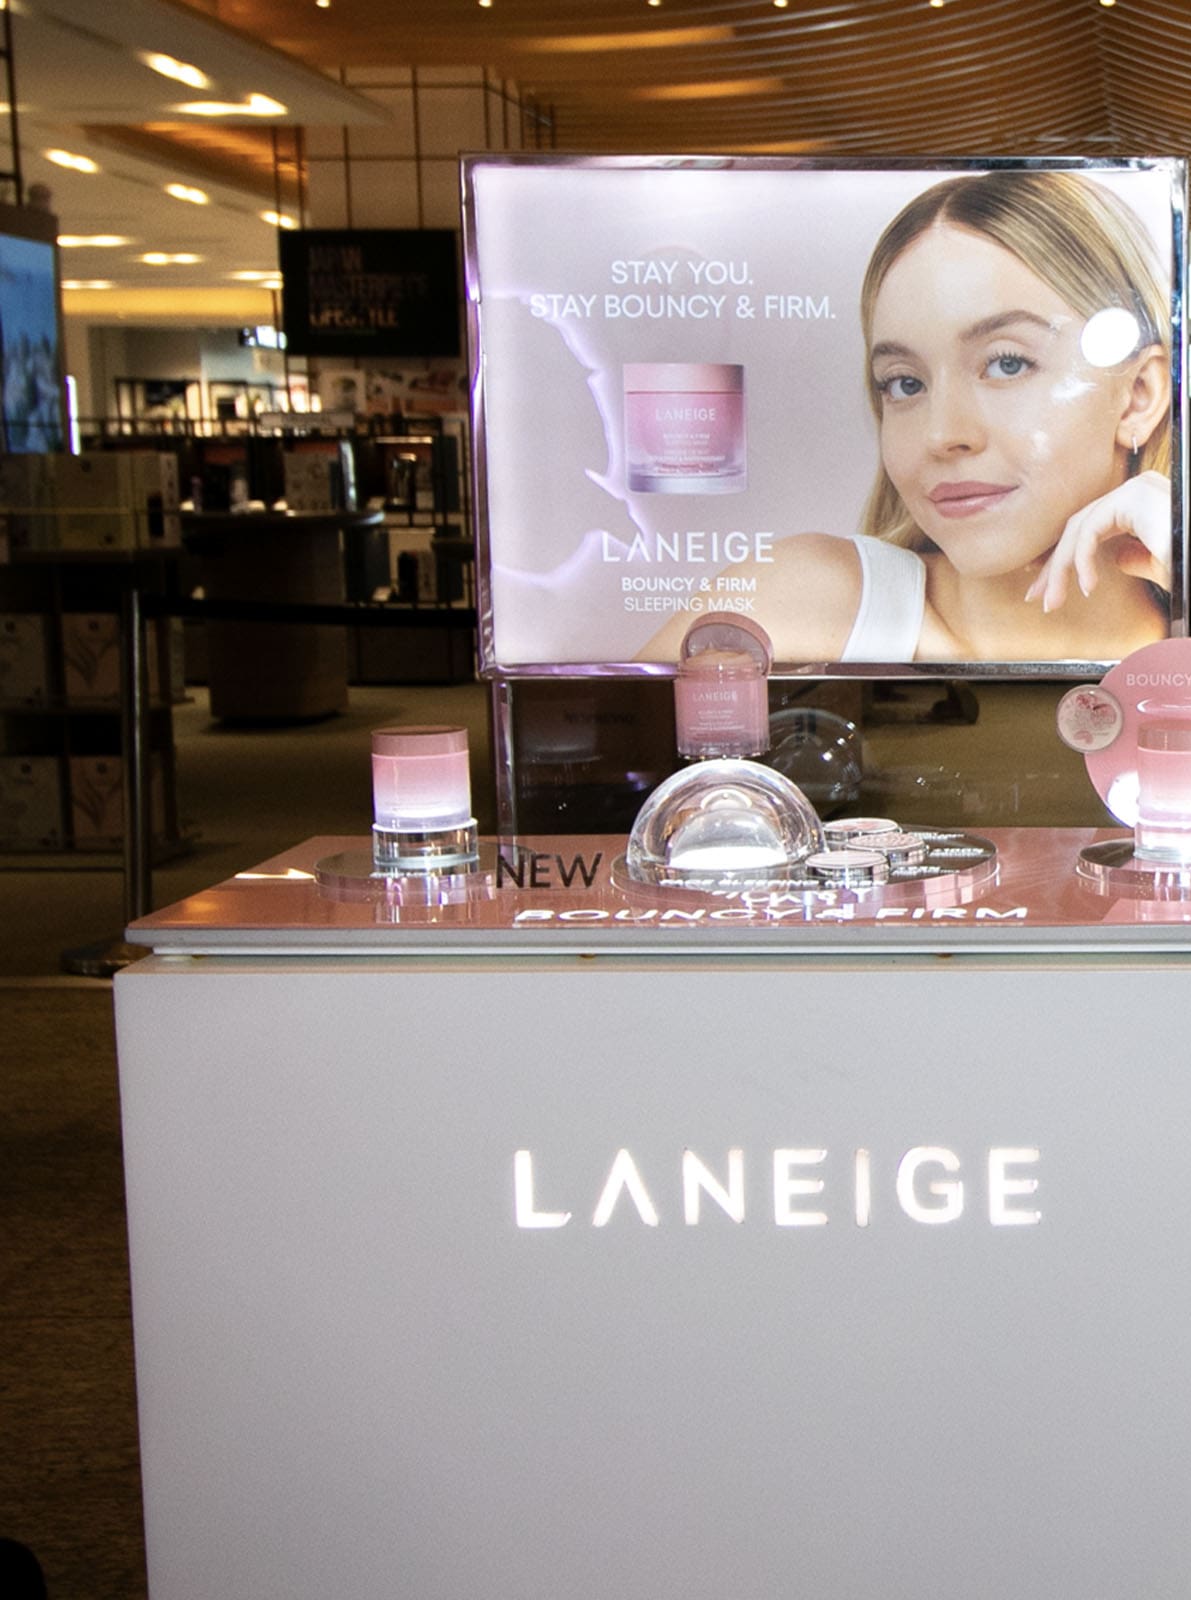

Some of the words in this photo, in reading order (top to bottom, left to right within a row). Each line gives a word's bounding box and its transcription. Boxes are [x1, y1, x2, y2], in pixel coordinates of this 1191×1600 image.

[611, 260, 675, 285] STAY
[686, 260, 754, 286] YOU.
[530, 294, 595, 319] STAY
[604, 294, 725, 319] BOUNCY
[735, 294, 756, 319] &
[765, 294, 837, 319] FIRM.
[655, 408, 717, 421] LANEIGE
[602, 531, 774, 563] LANEIGE
[621, 577, 697, 592] BOUNCY
[700, 577, 713, 592] &
[717, 577, 757, 592] FIRM
[624, 597, 703, 613] SLEEPING
[708, 597, 755, 613] MASK
[495, 852, 602, 889] NEW
[514, 909, 803, 921] BOUNCY
[875, 907, 1028, 920] FIRM
[514, 1146, 1041, 1227] LANEIGE
